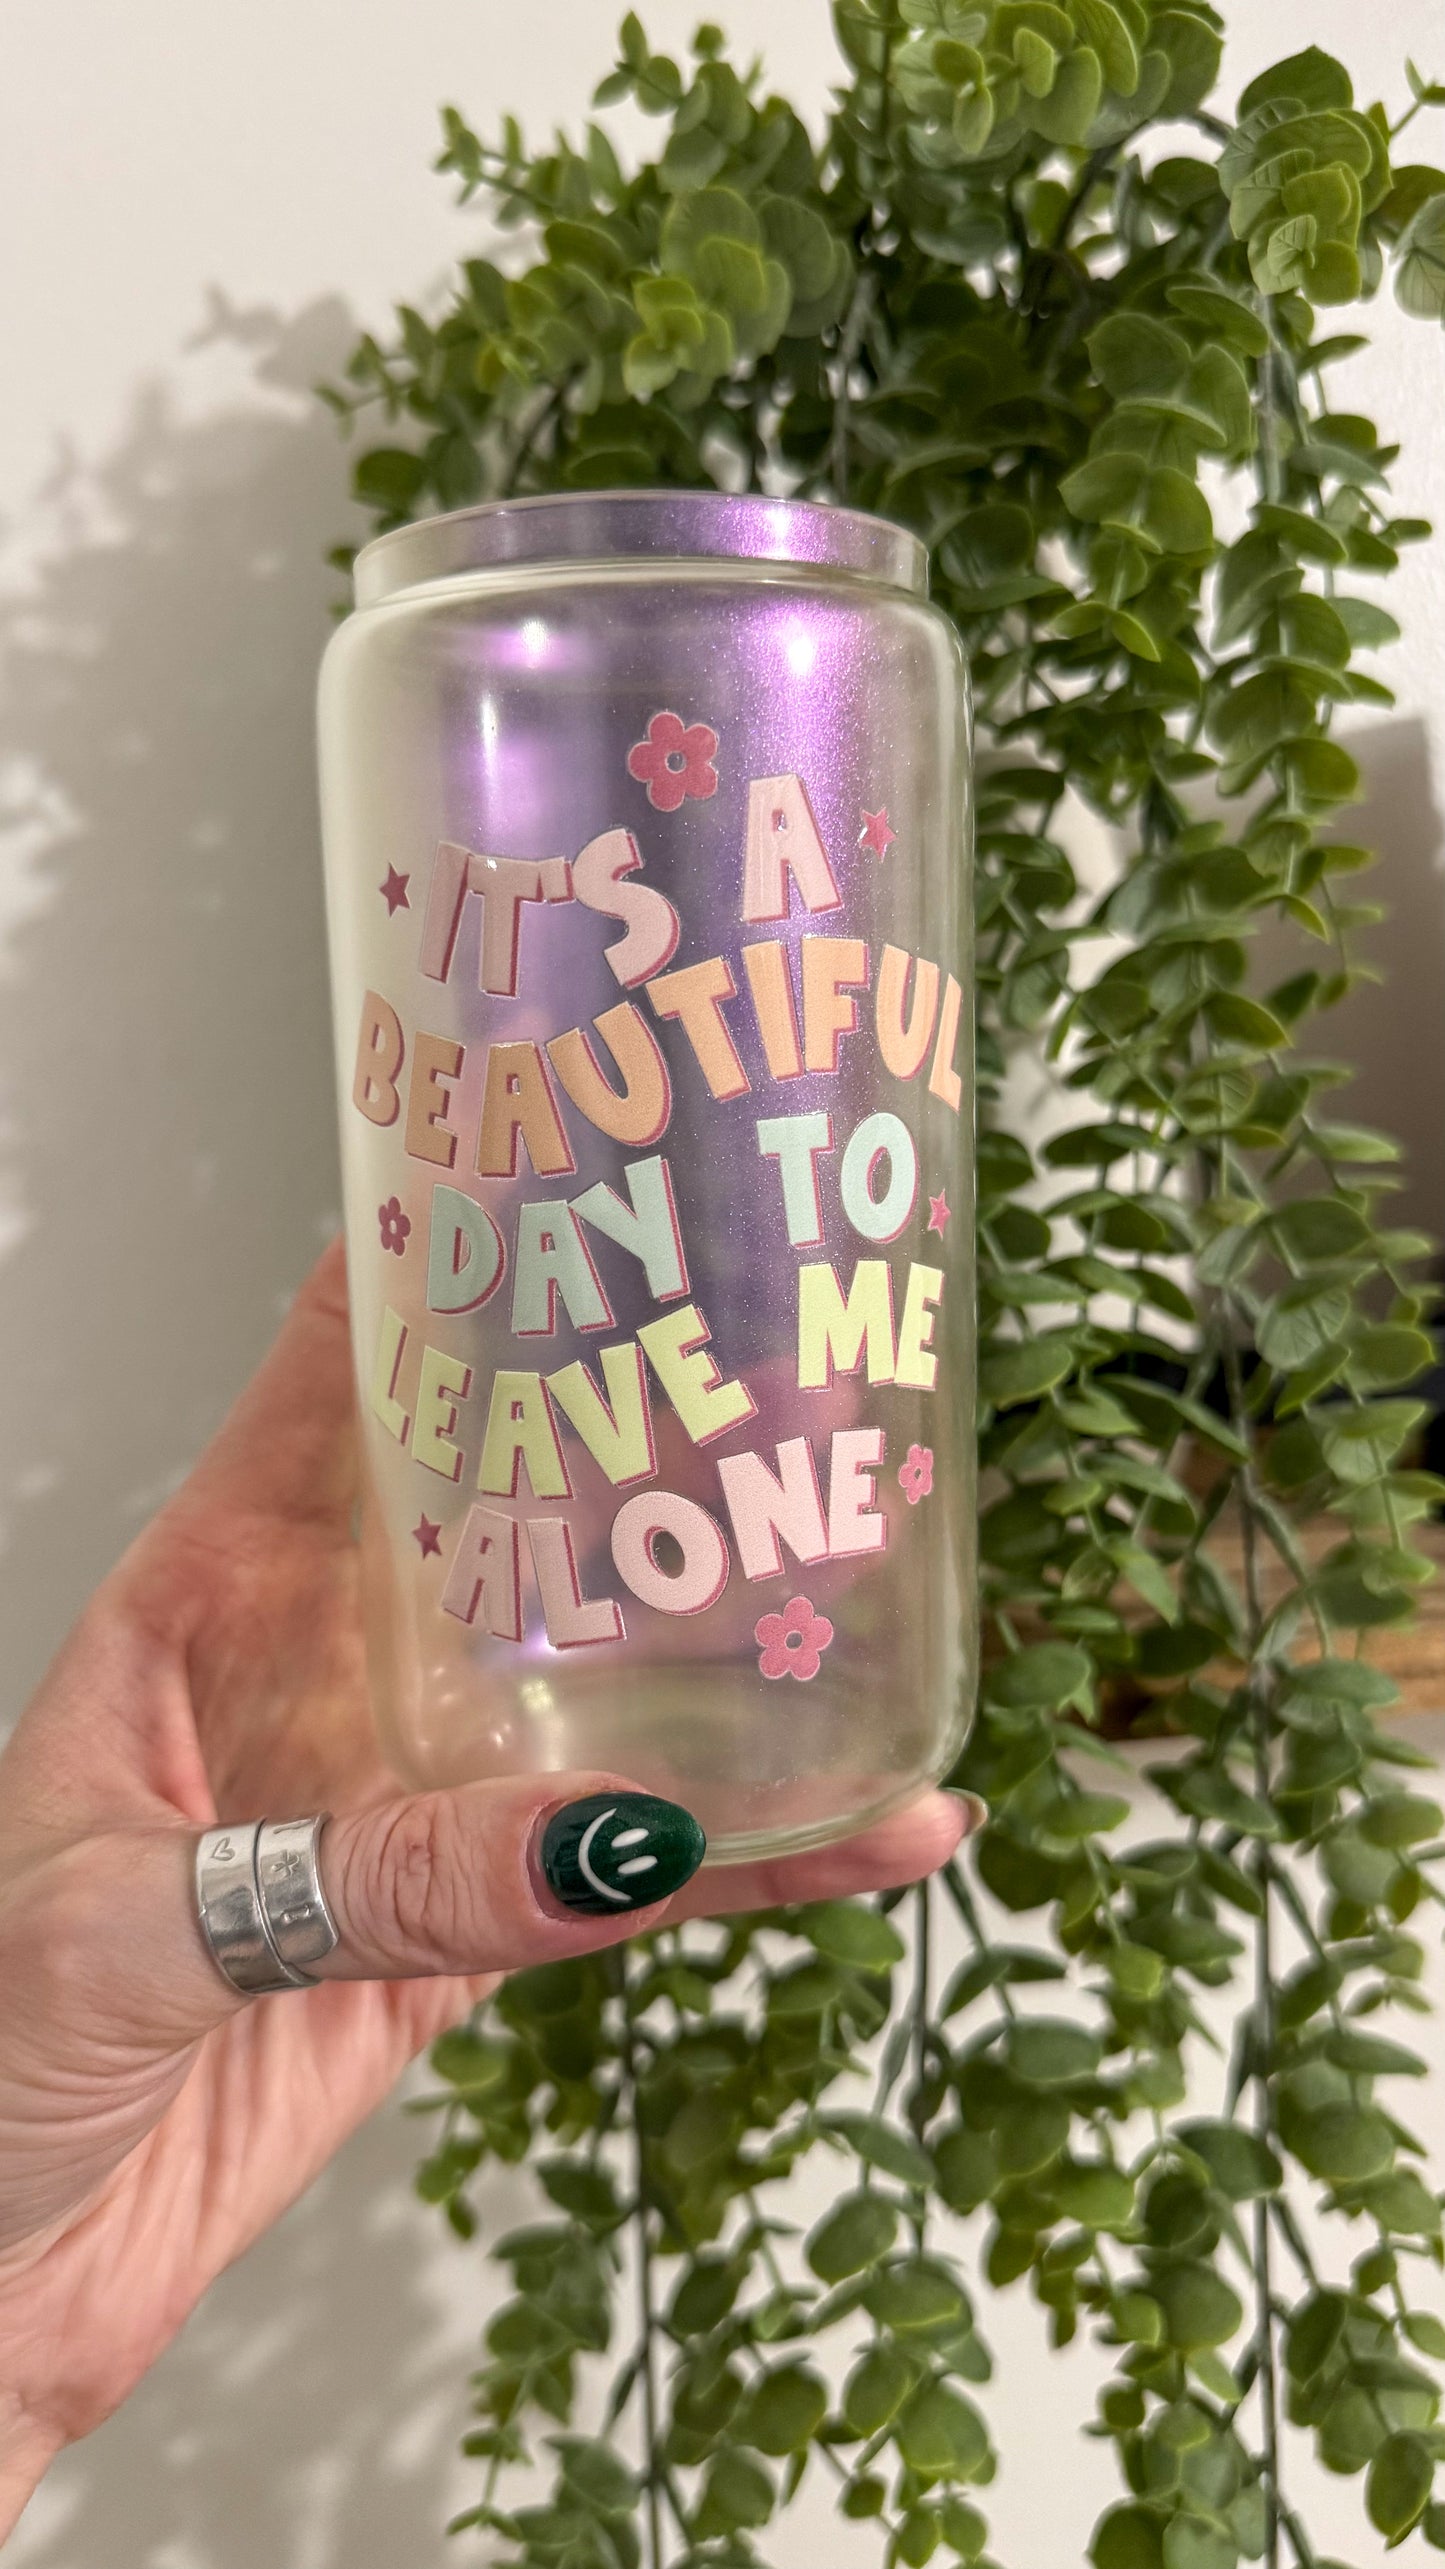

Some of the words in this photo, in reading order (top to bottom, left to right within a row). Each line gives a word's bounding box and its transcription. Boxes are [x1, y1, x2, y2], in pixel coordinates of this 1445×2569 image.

[742, 773, 844, 922] A
[352, 936, 962, 1179] BEAUTIFUL
[426, 1154, 690, 1336] DAY
[757, 1112, 919, 1250] TO
[371, 1304, 758, 1500] LEAVE
[798, 1260, 943, 1391] ME
[441, 1428, 886, 1650] ALONE
